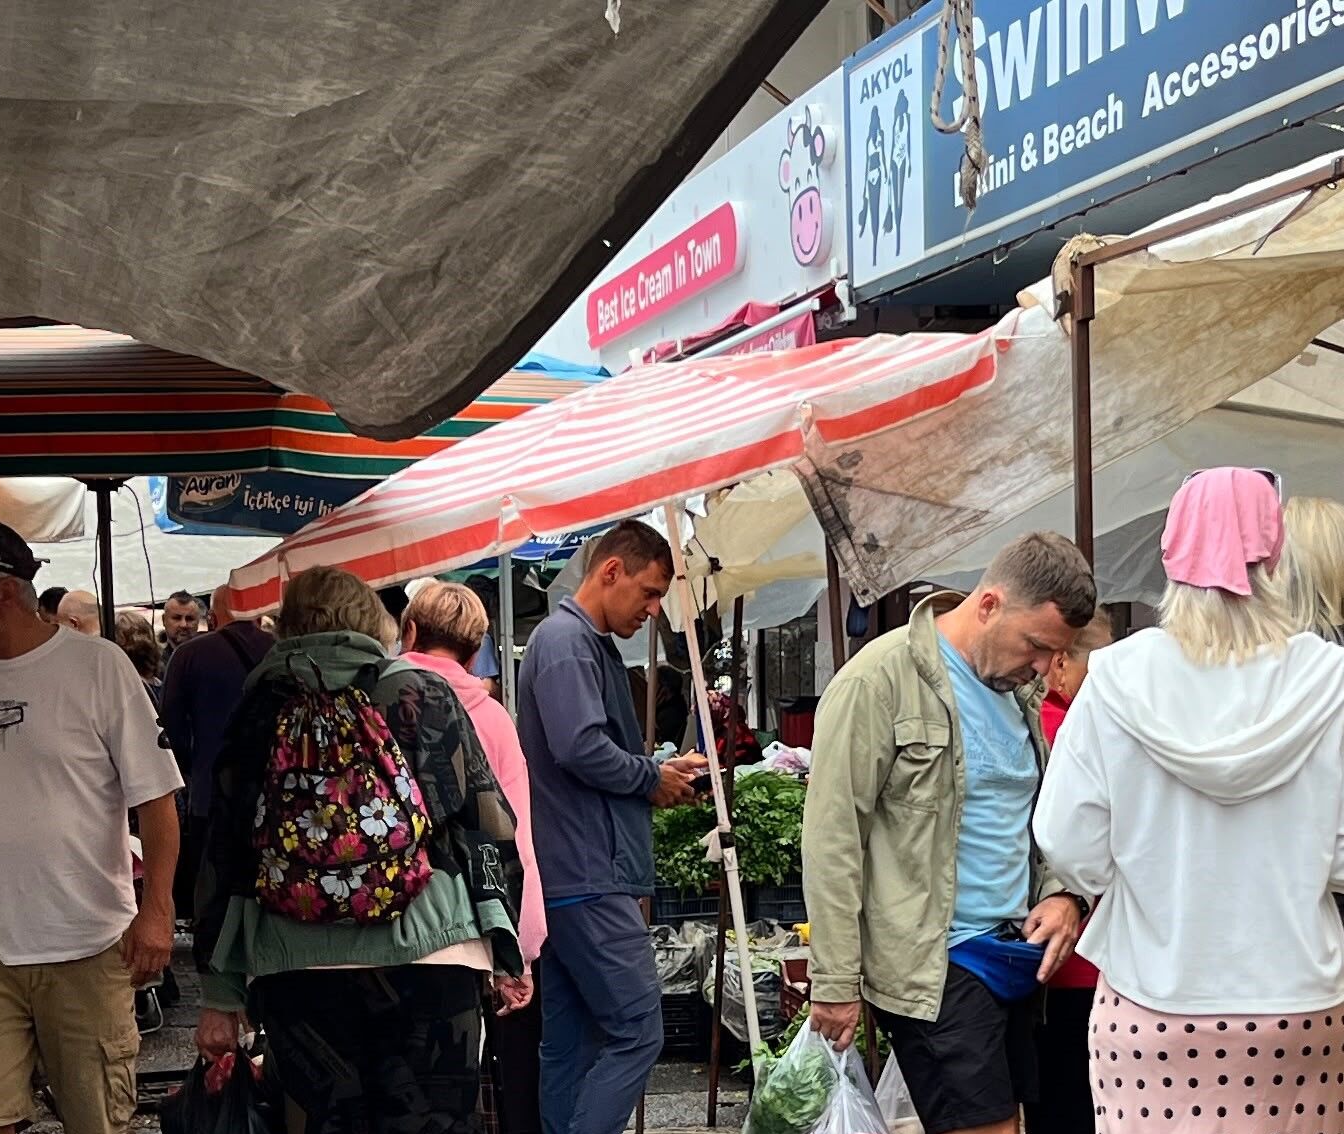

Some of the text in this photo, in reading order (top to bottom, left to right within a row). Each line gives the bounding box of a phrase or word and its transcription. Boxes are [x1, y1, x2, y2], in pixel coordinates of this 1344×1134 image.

[860, 53, 913, 104] AKYOL
[1020, 132, 1038, 172] &
[1043, 92, 1123, 165] Beach
[597, 232, 721, 335] Best Ice Cream In Town
[185, 471, 238, 497] Ayran
[243, 484, 291, 514] İçtikçe
[294, 494, 315, 516] iyi
